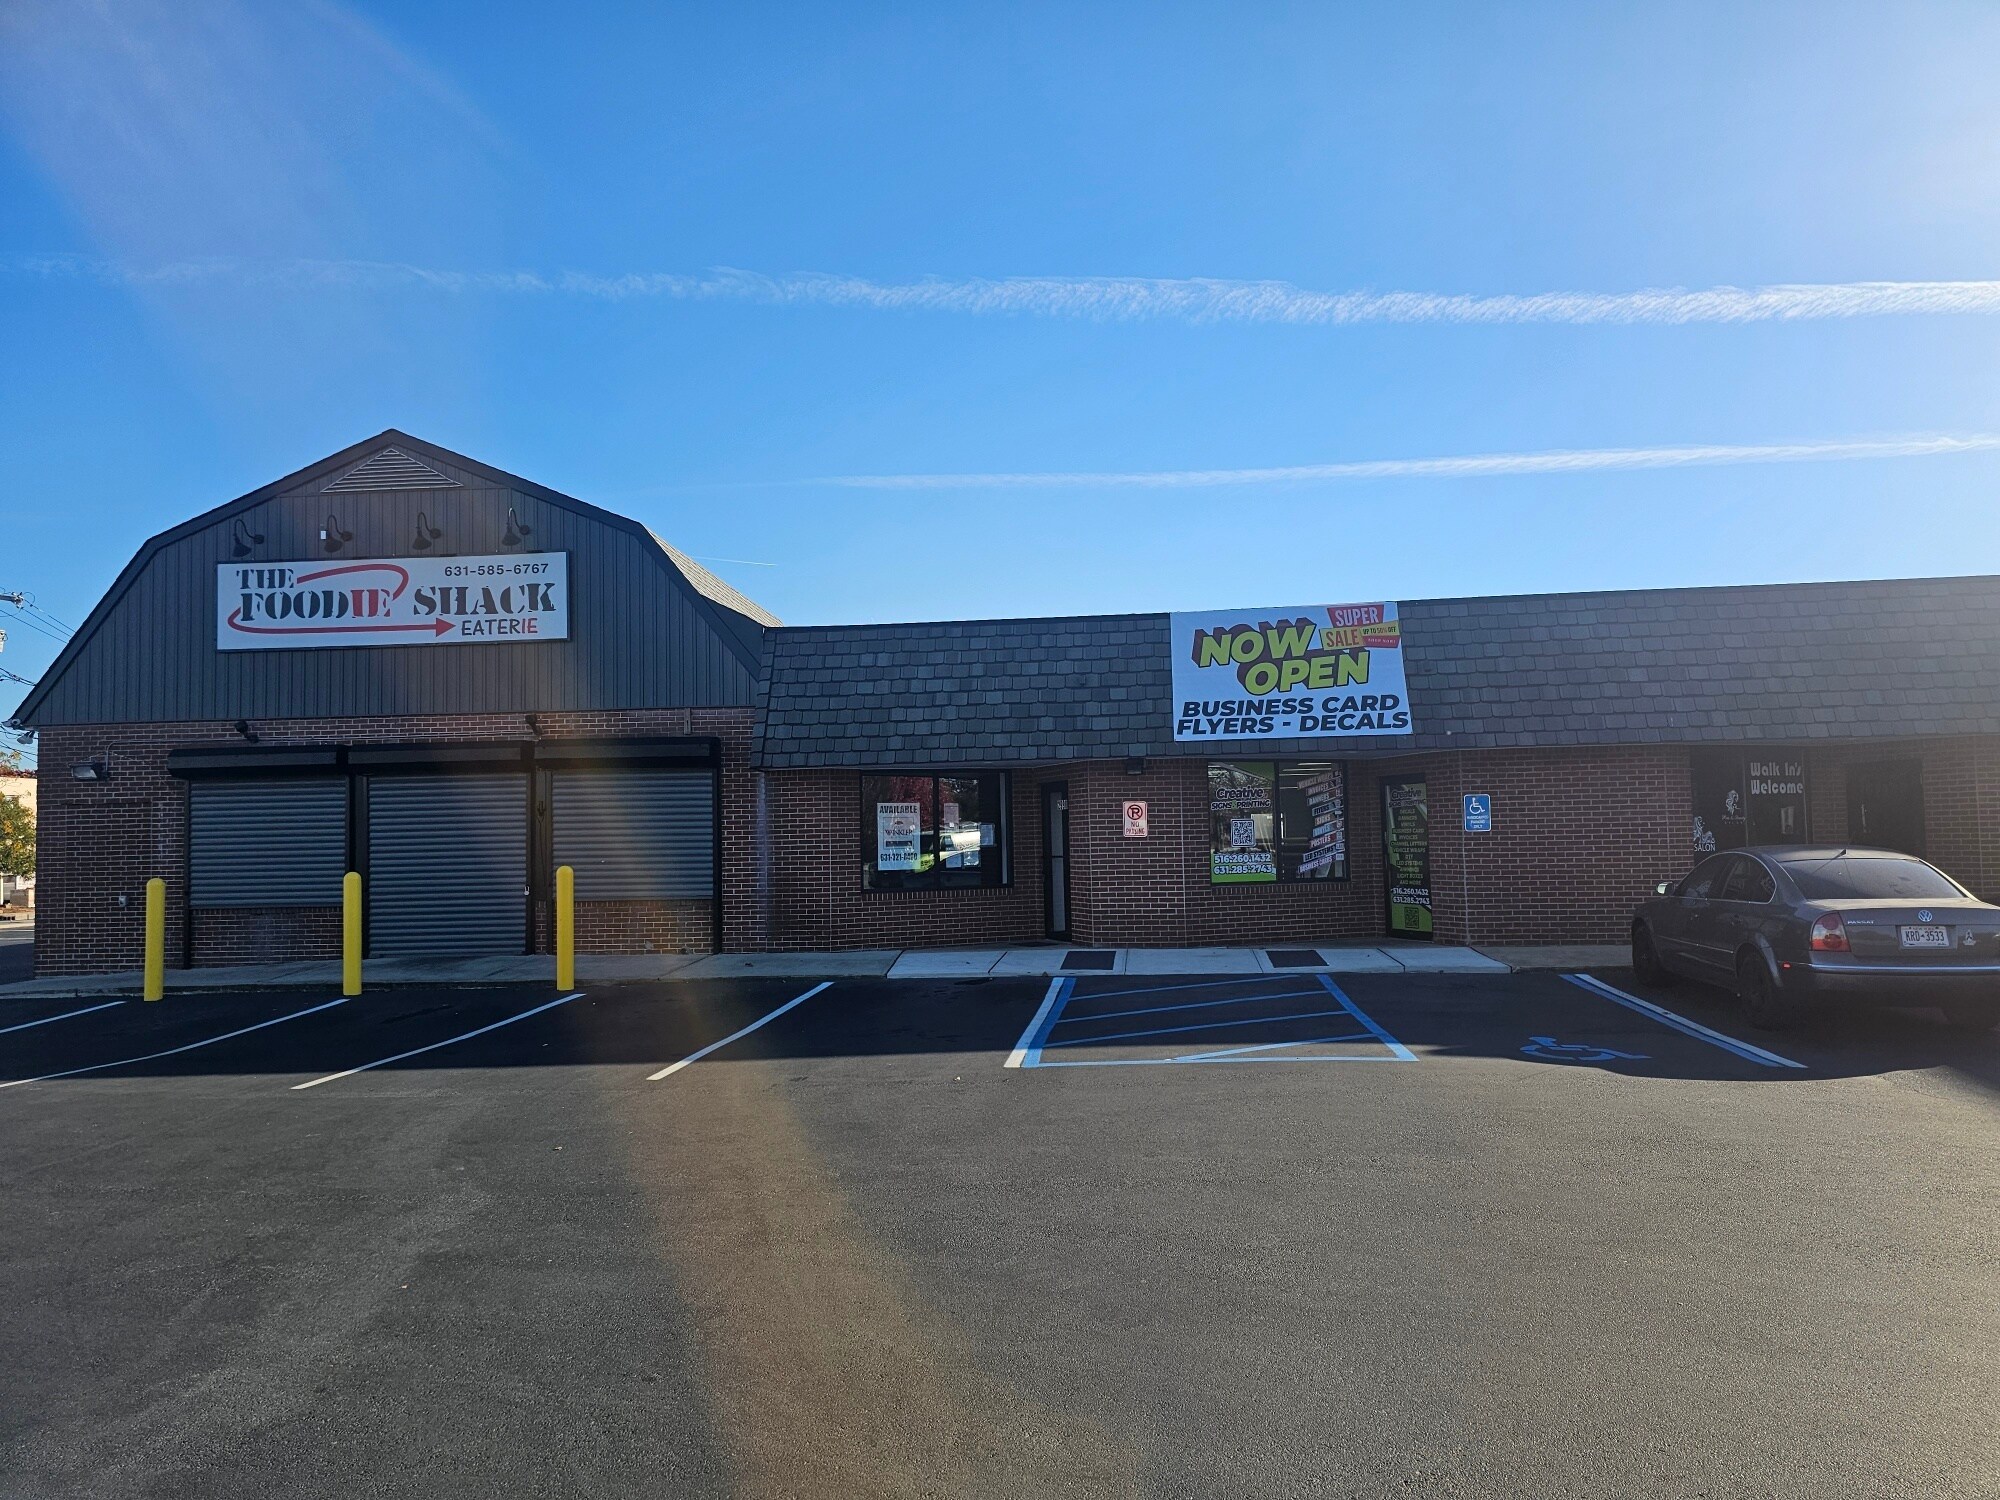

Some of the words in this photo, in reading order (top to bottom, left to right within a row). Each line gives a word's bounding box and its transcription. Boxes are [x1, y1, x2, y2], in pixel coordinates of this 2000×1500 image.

[236, 568, 294, 589] THE
[444, 563, 549, 577] 631-585-6767
[240, 588, 391, 621] FOODIE
[413, 582, 556, 616] SHACK
[1335, 606, 1379, 627] SUPER
[461, 618, 538, 636] EATERIE
[1387, 625, 1396, 633] OFF
[1197, 621, 1317, 668] NOW
[1325, 629, 1360, 649] SALE
[1242, 651, 1370, 696] OPEN
[1182, 697, 1314, 718] BUSINESS
[1322, 694, 1399, 713] CARD
[1177, 716, 1274, 735] FLYERS
[1299, 711, 1409, 731] DECALS
[1750, 761, 1780, 777] Walk
[1785, 761, 1801, 777] In's
[1217, 785, 1264, 799] Creative
[1392, 787, 1422, 799] Creative
[1750, 780, 1804, 795] Welcome
[879, 804, 918, 814] AVAILABLE
[1694, 843, 1716, 852] SALON
[1214, 853, 1271, 863] 516.260.1432
[1213, 865, 1272, 875] 631.285.2743
